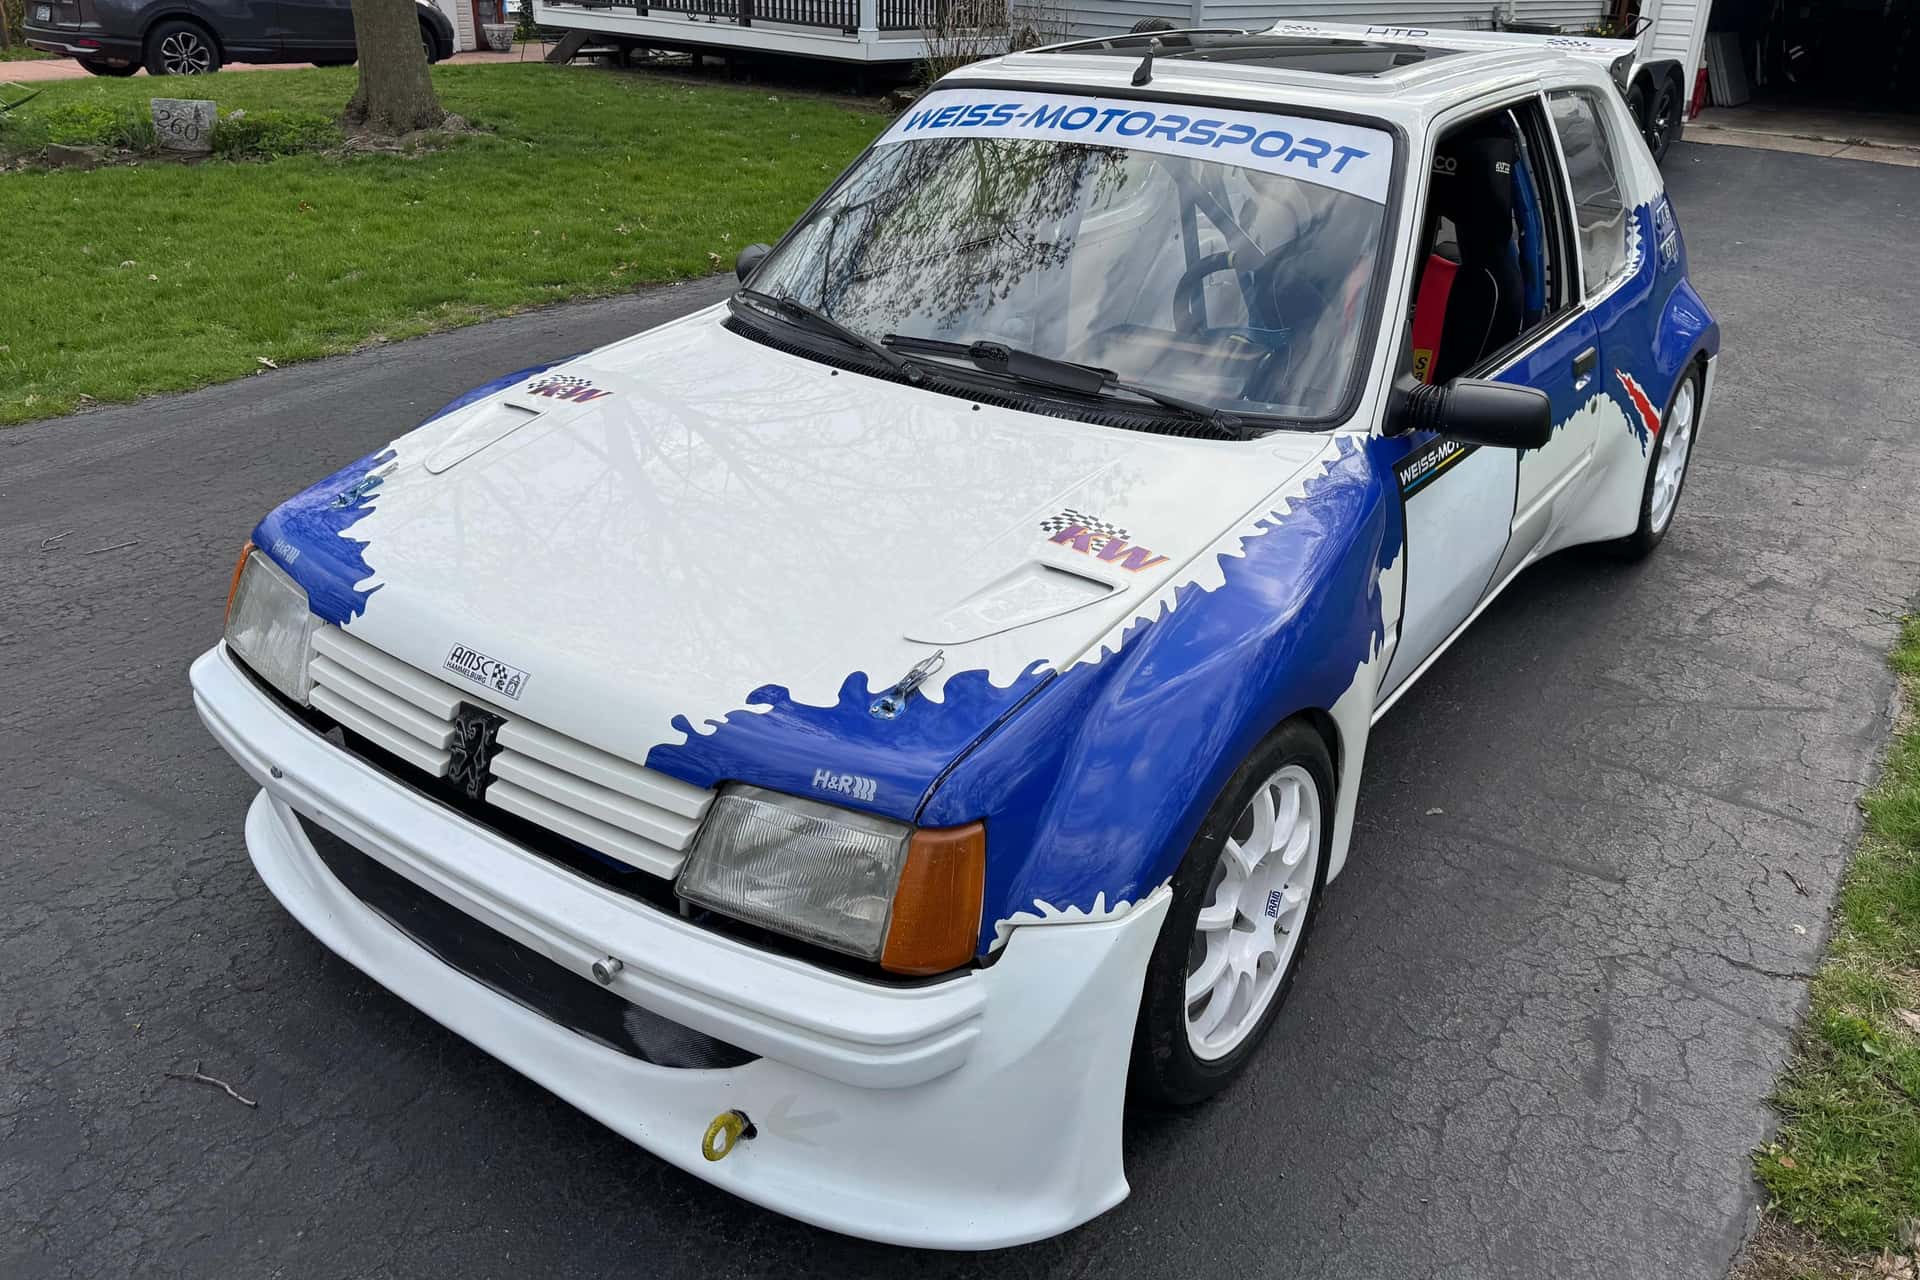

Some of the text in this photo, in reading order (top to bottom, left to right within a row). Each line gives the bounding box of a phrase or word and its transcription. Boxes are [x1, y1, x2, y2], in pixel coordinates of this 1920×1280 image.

[157, 109, 199, 142] 260
[903, 103, 1372, 174] WEISS-MOTORSPORT
[1048, 521, 1170, 573] KW
[450, 646, 495, 677] AMSC
[1267, 890, 1281, 918] BRAID
